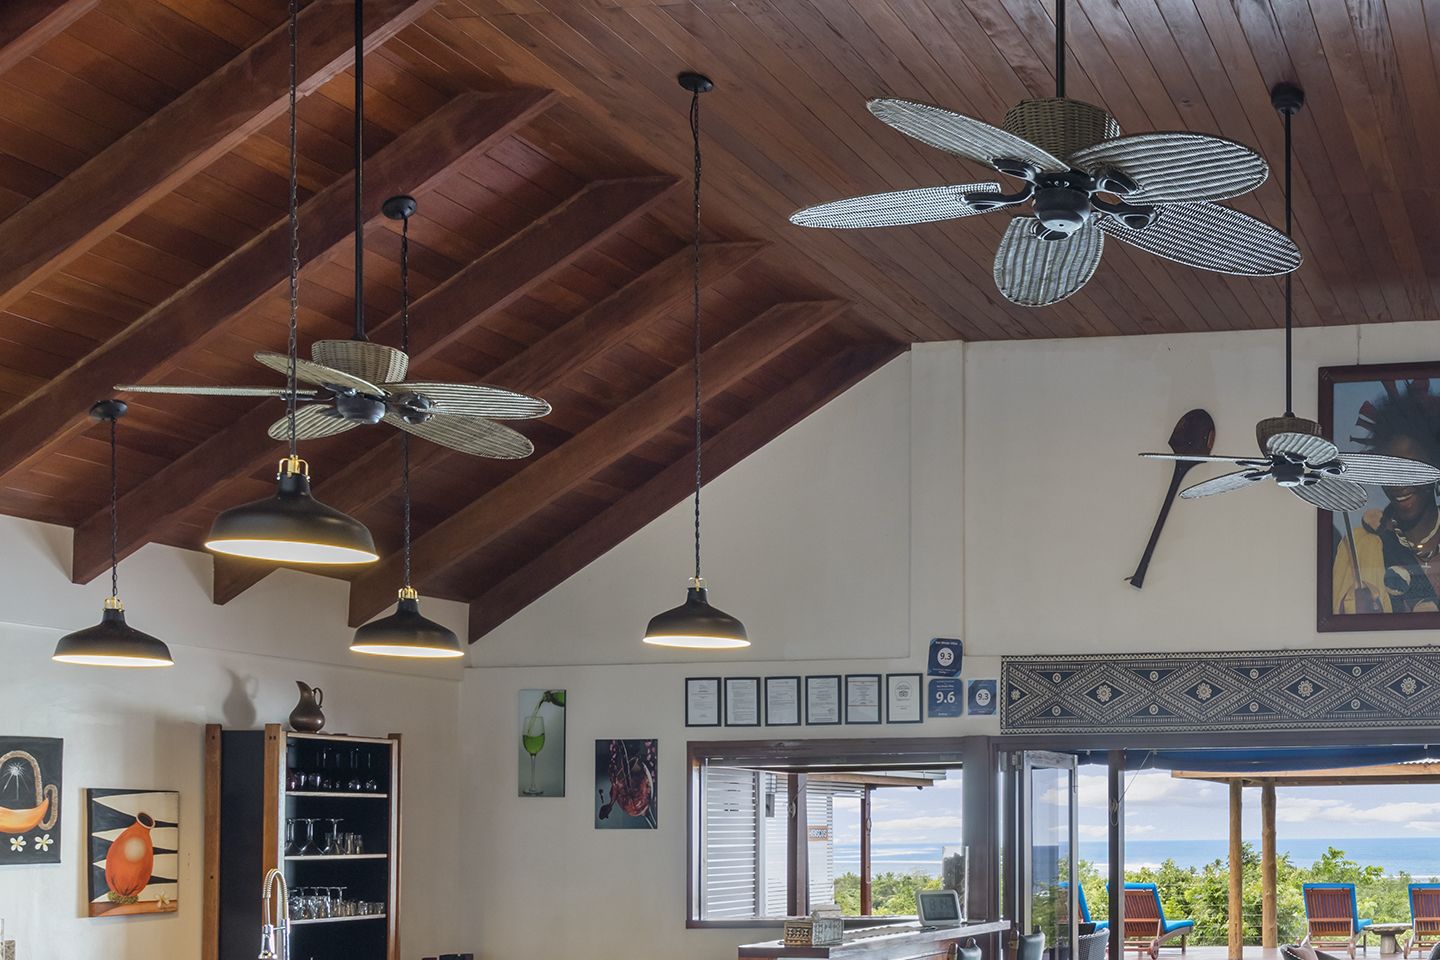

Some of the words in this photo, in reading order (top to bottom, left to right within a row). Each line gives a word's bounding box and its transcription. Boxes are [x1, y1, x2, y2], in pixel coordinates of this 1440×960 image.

[940, 652, 952, 660] 9.3
[936, 691, 956, 704] 9.6
[977, 692, 989, 700] 9.3
